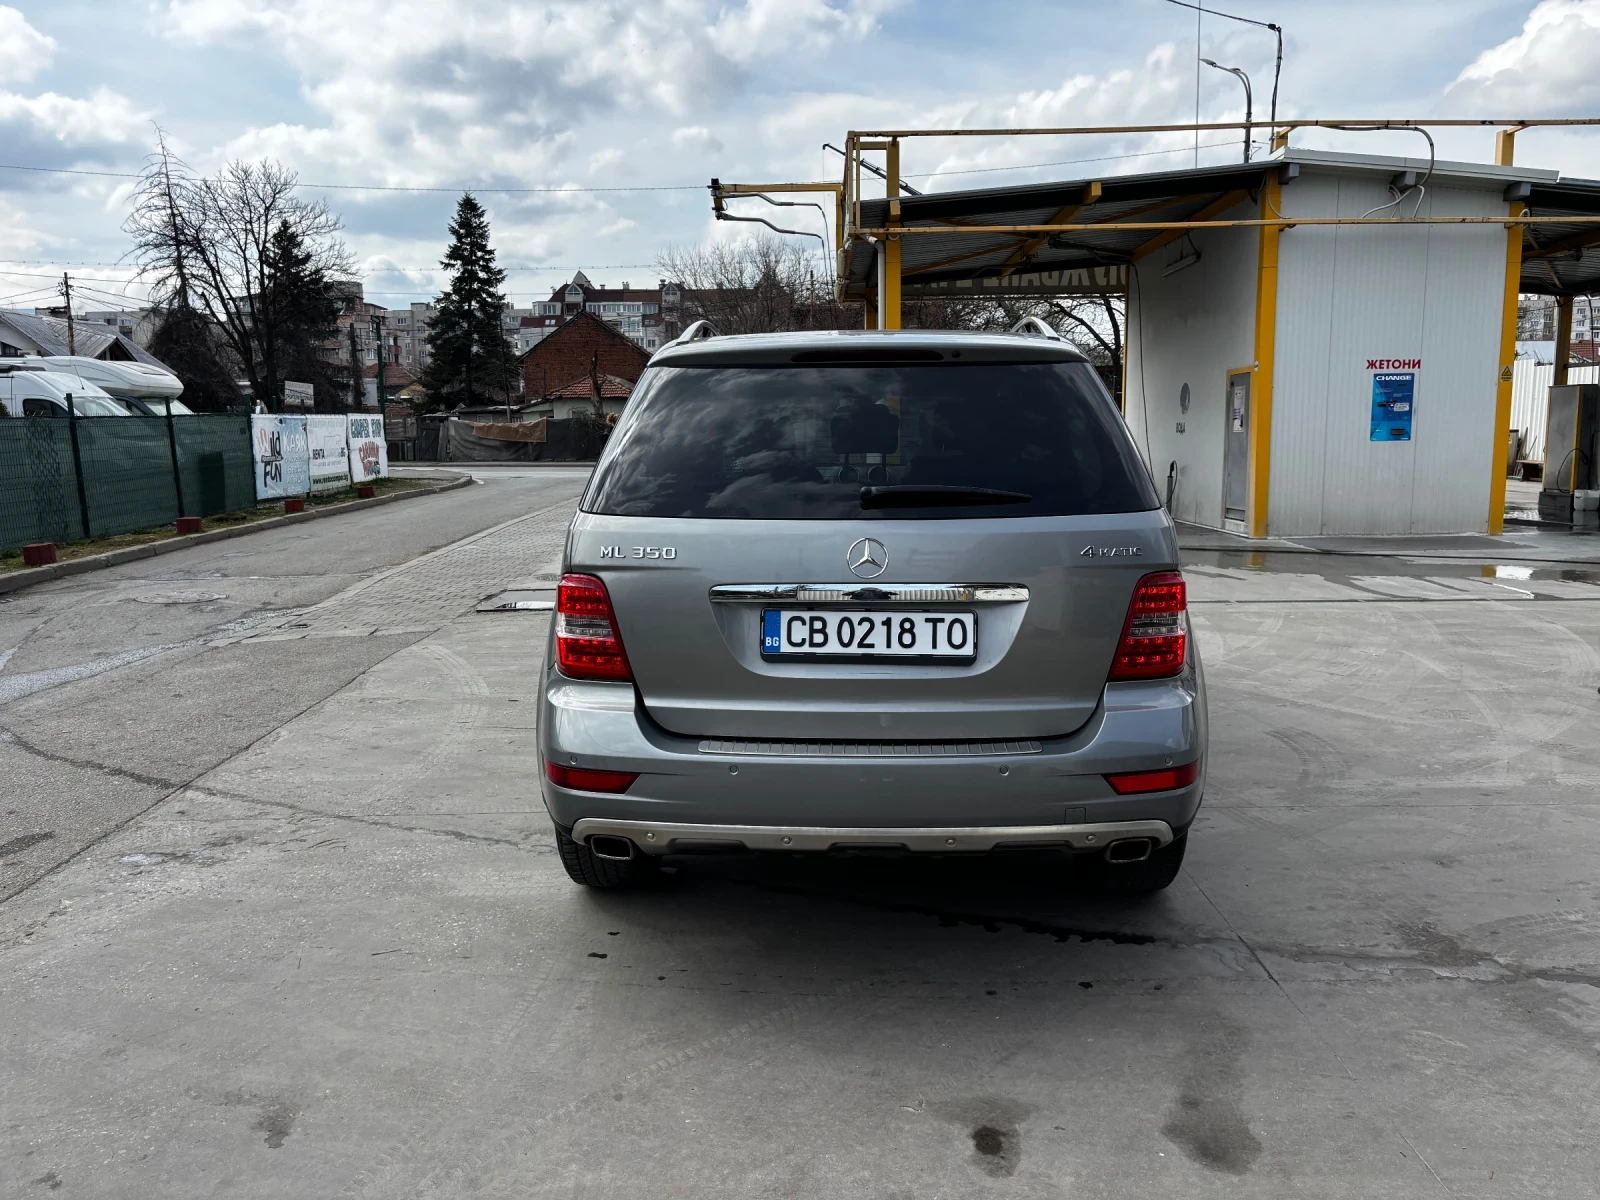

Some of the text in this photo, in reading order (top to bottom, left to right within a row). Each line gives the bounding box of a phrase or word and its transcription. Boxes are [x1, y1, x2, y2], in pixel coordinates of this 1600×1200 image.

[1366, 359, 1421, 370] ЖЕТОНИ
[264, 461, 282, 488] FUN
[600, 546, 677, 560] ML 350
[786, 615, 968, 650] CB 0218 TO
[765, 636, 780, 647] BG
